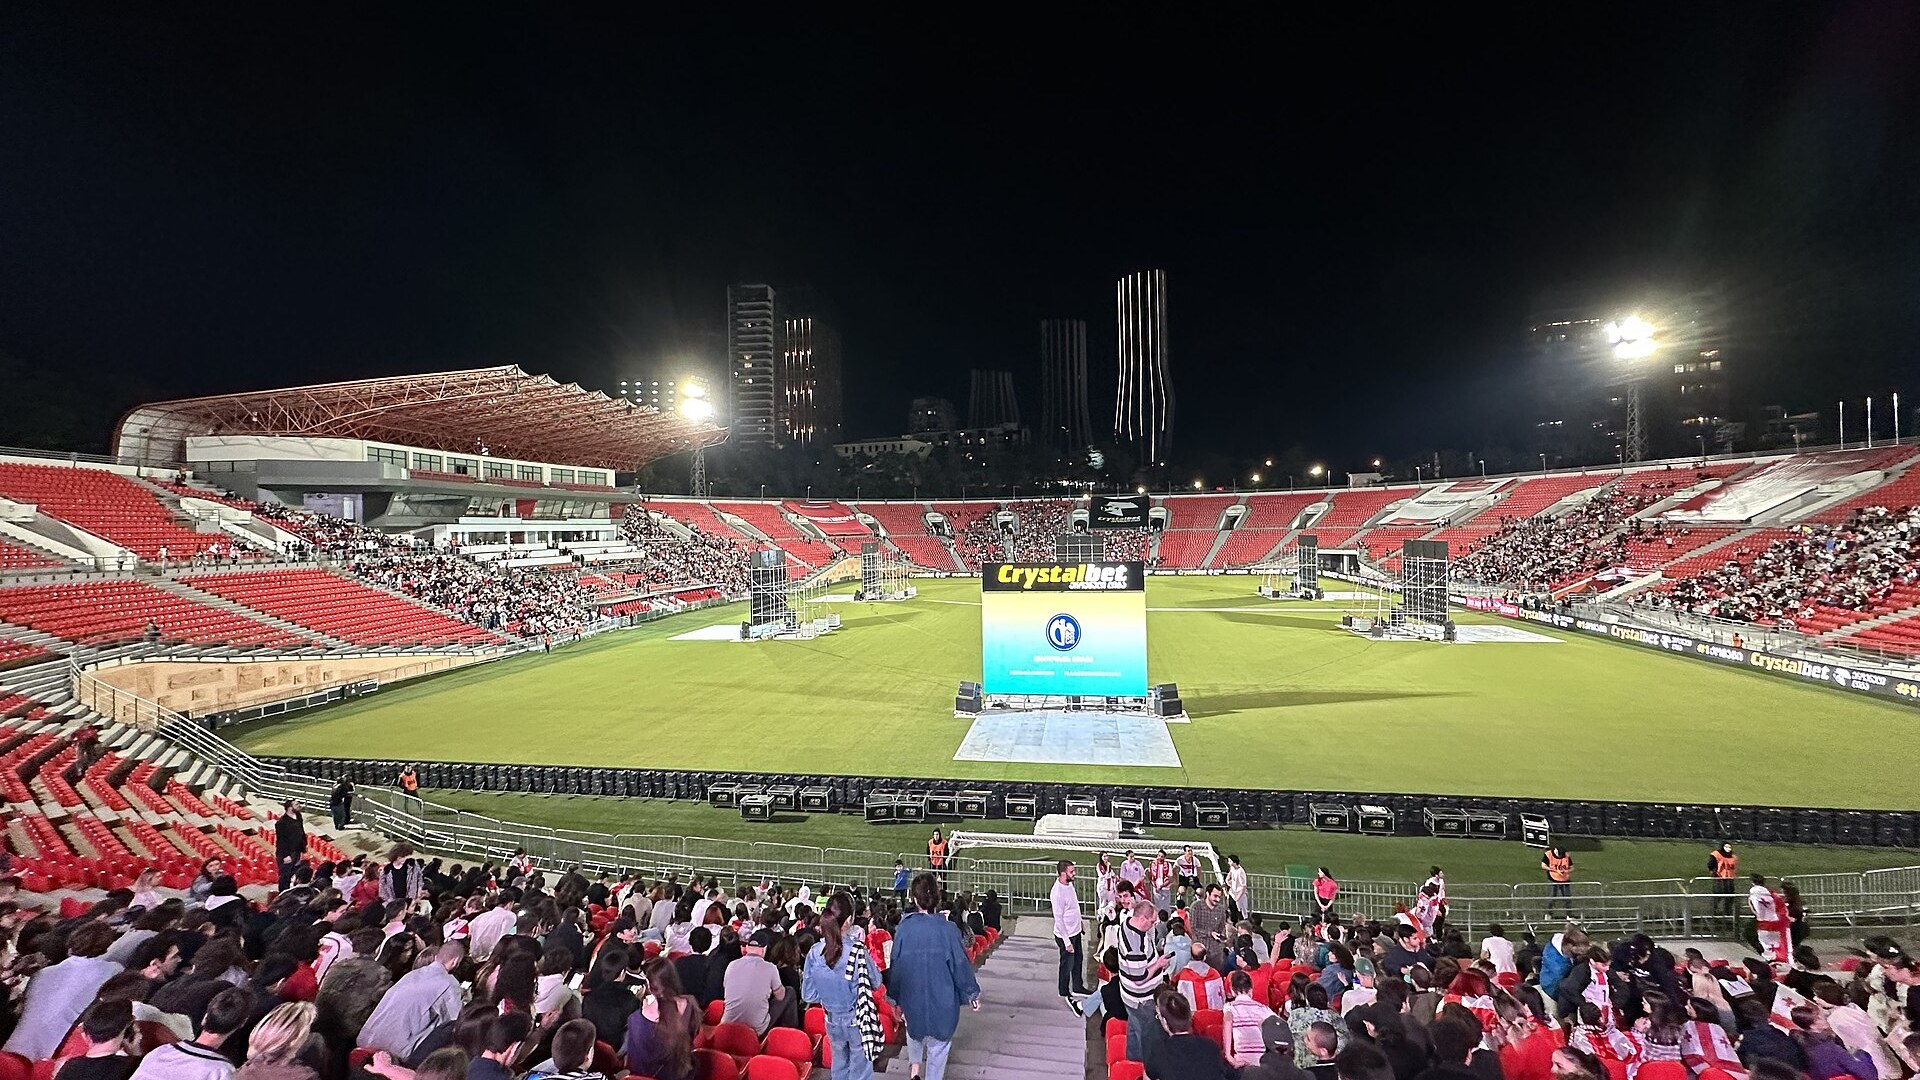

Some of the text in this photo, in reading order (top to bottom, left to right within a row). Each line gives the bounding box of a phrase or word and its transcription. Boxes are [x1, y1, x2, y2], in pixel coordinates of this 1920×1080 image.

[997, 563, 1128, 590] Crystalbet
[1518, 607, 1553, 623] Crystalbet
[1610, 624, 1660, 646] Crystalbet
[1750, 651, 1831, 681] Crystalbet
